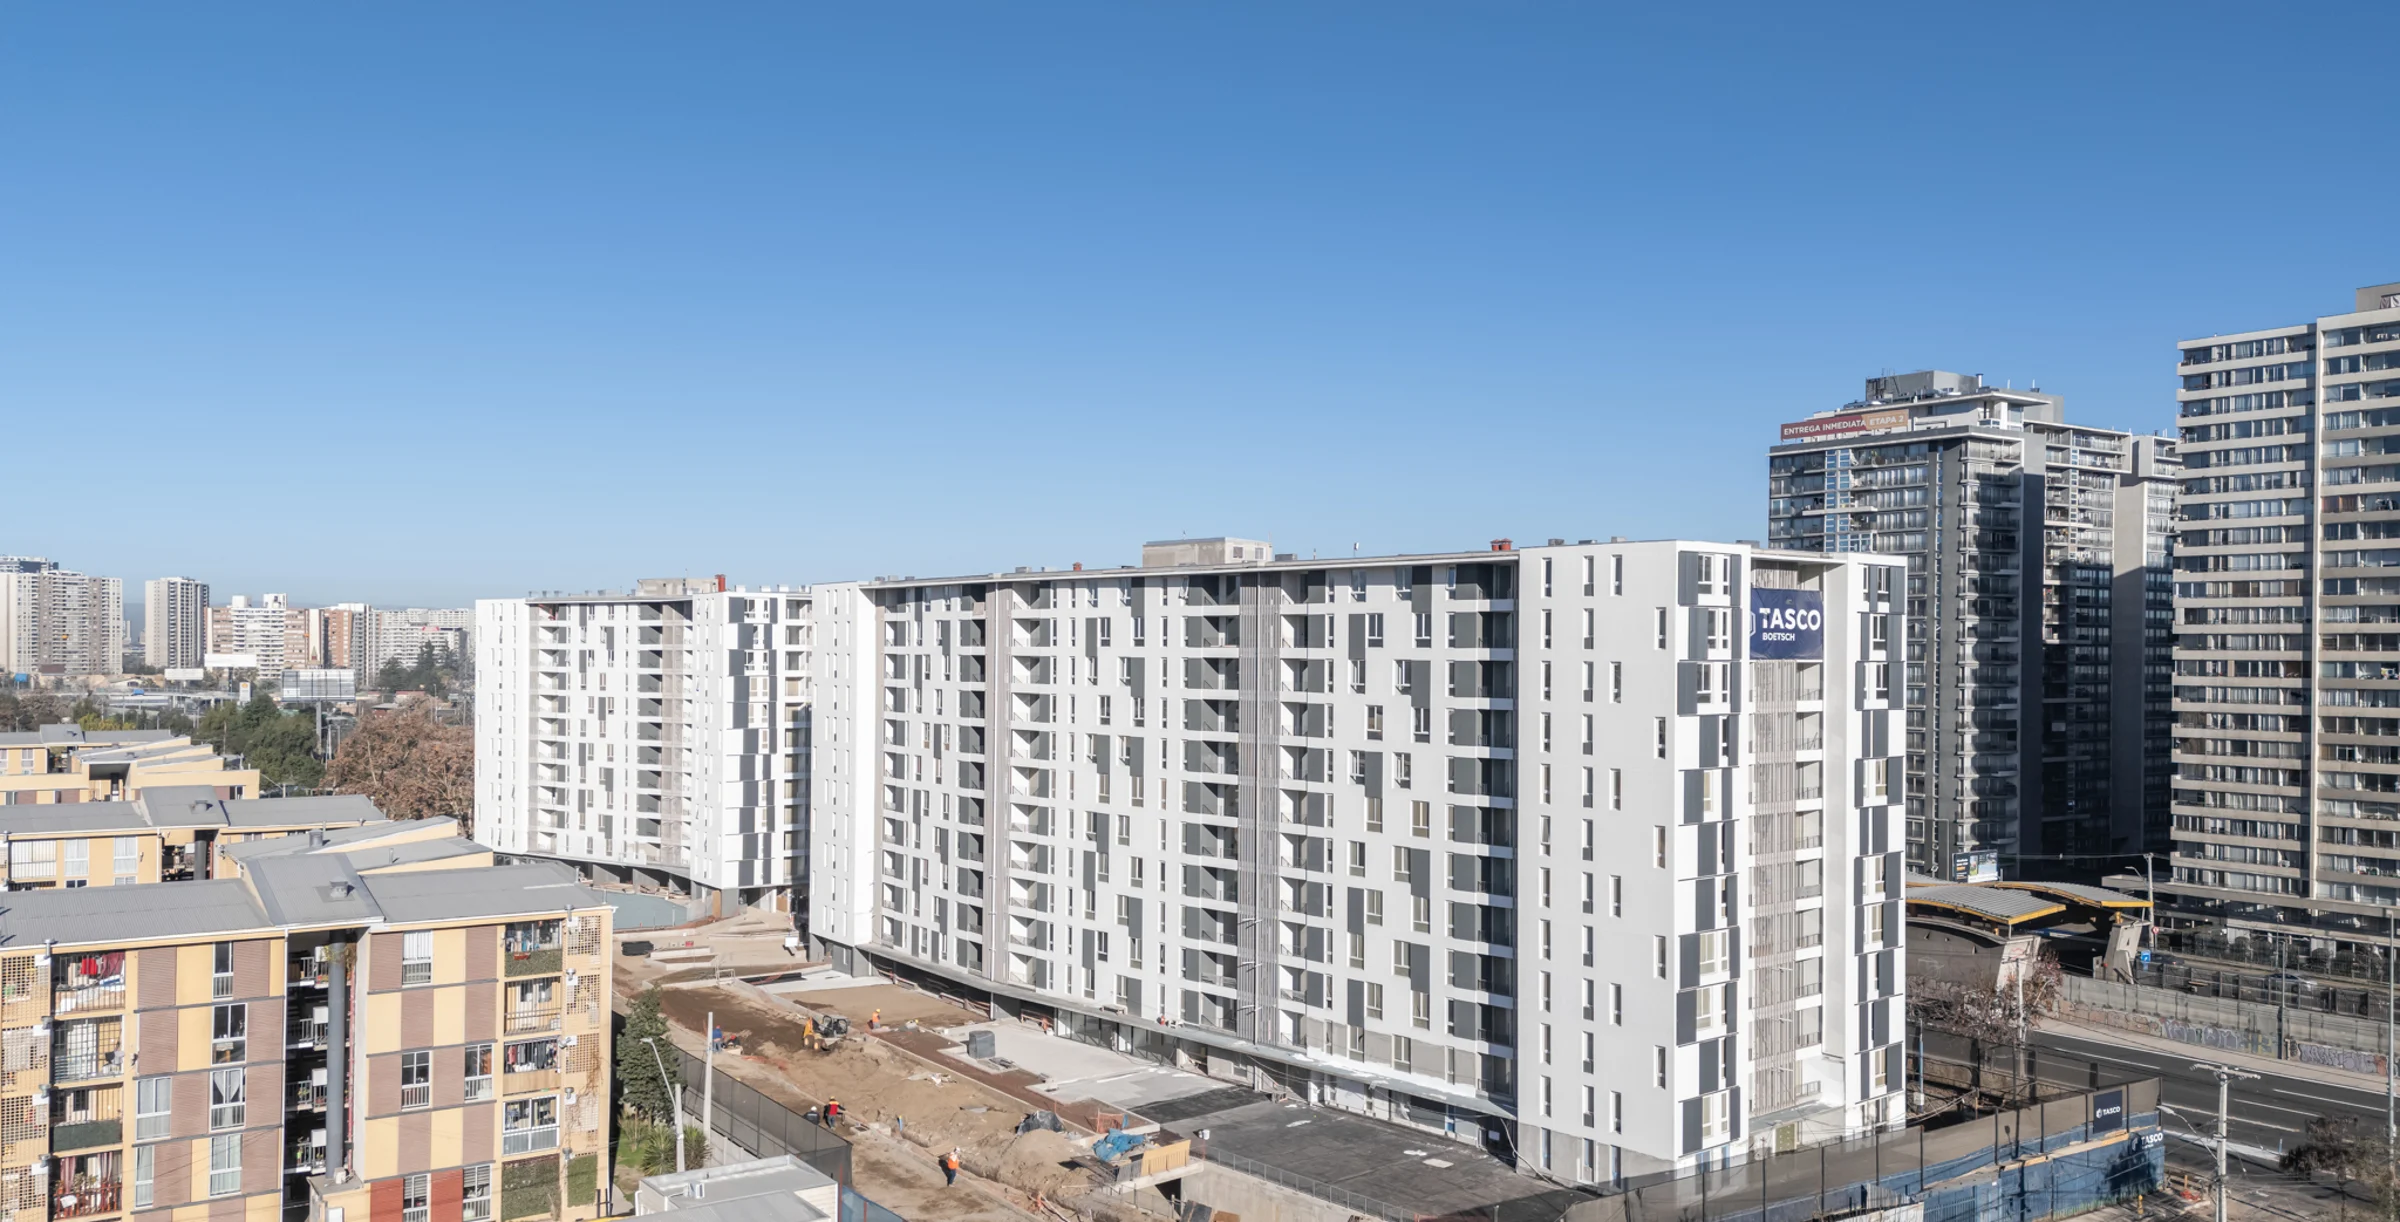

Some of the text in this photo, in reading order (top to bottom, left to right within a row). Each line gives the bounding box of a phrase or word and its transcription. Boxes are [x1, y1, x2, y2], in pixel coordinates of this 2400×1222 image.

[1784, 425, 1820, 435] ENTREGA
[1822, 419, 1866, 431] INMEDIATA
[1869, 416, 1897, 426] ETAPA
[1759, 608, 1821, 630] TASCO
[1762, 632, 1795, 641] BOETSCH
[2103, 1106, 2121, 1115] TASCO
[2141, 1133, 2163, 1144] TASCO
